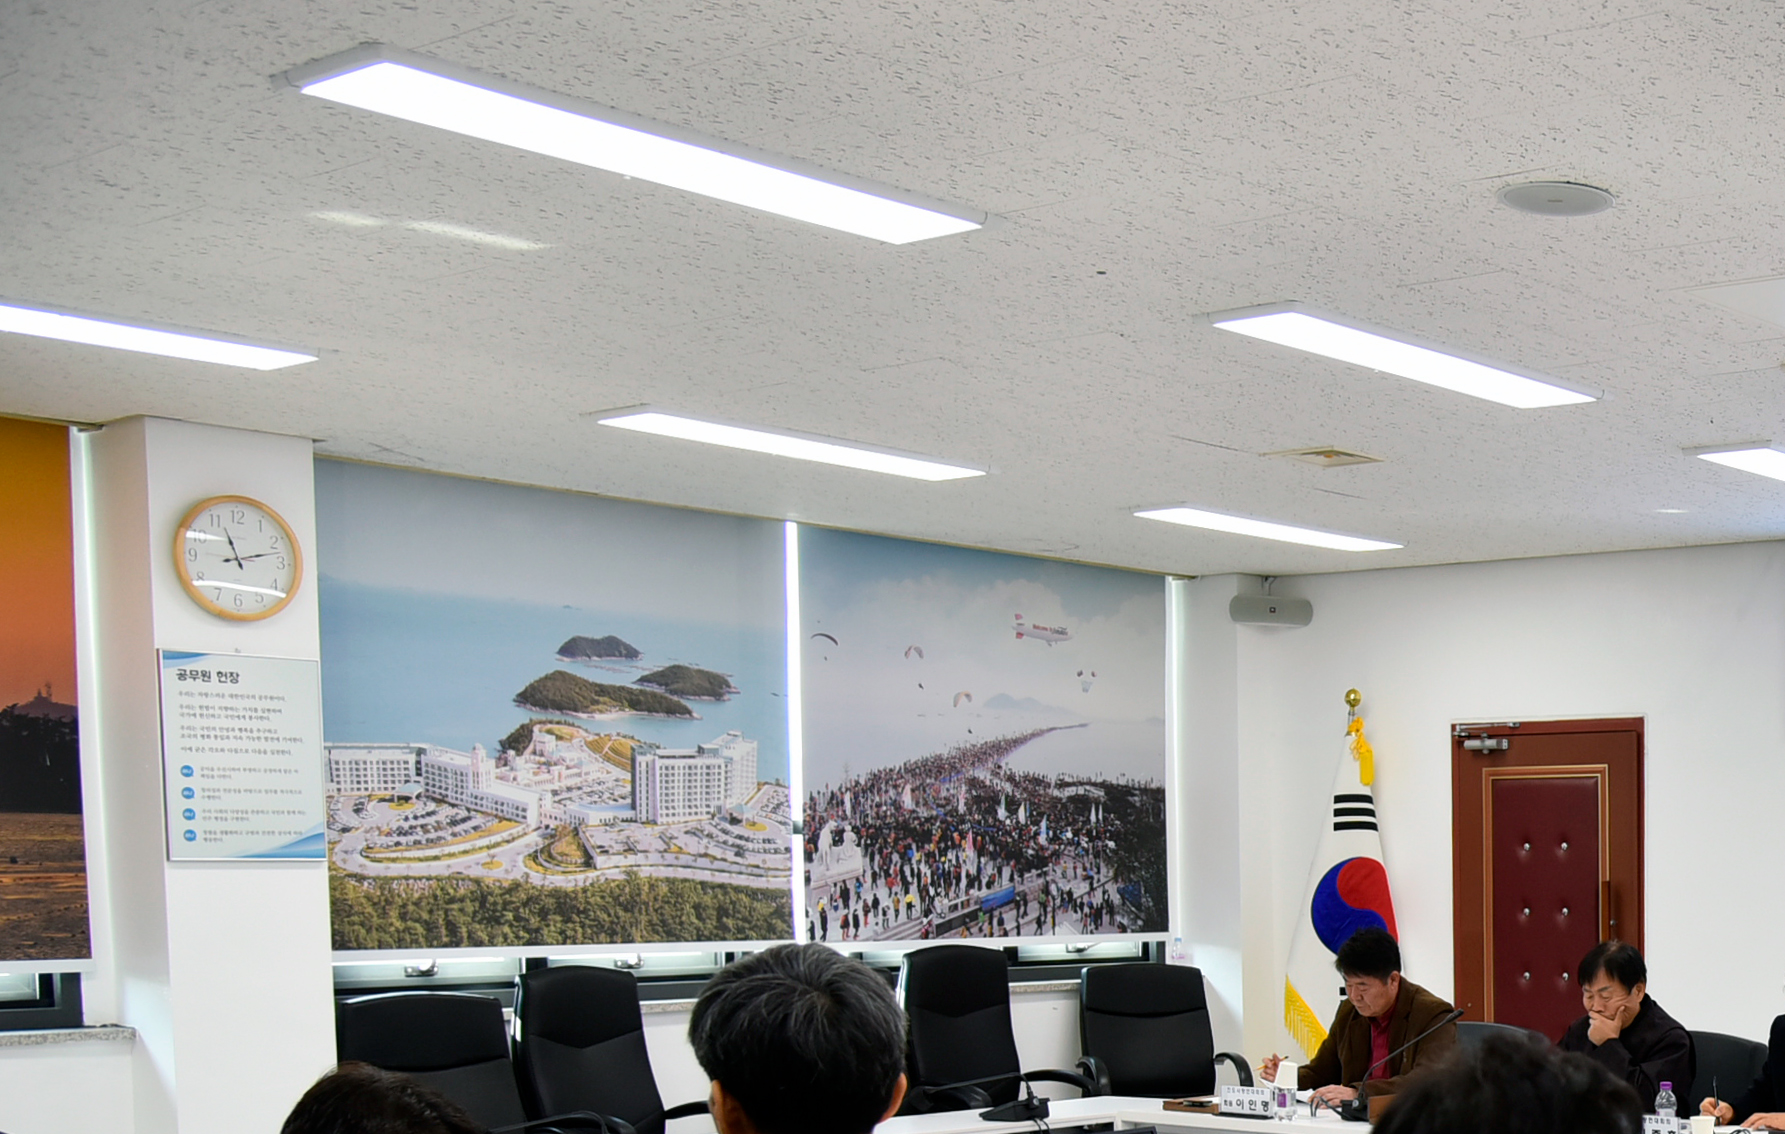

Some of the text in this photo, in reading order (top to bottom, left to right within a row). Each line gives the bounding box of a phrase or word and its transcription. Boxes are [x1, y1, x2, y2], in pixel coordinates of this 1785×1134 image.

[209, 513, 221, 528] 11
[230, 509, 245, 525] 12
[258, 519, 263, 533] 1
[192, 528, 207, 544] 10
[269, 535, 279, 550] 2
[188, 547, 198, 562] 9
[276, 556, 286, 570] 3
[270, 577, 278, 591] 4
[214, 587, 222, 601] 7
[233, 593, 243, 608] 6
[255, 591, 265, 604] 5
[176, 668, 240, 684] 공무원 헌장
